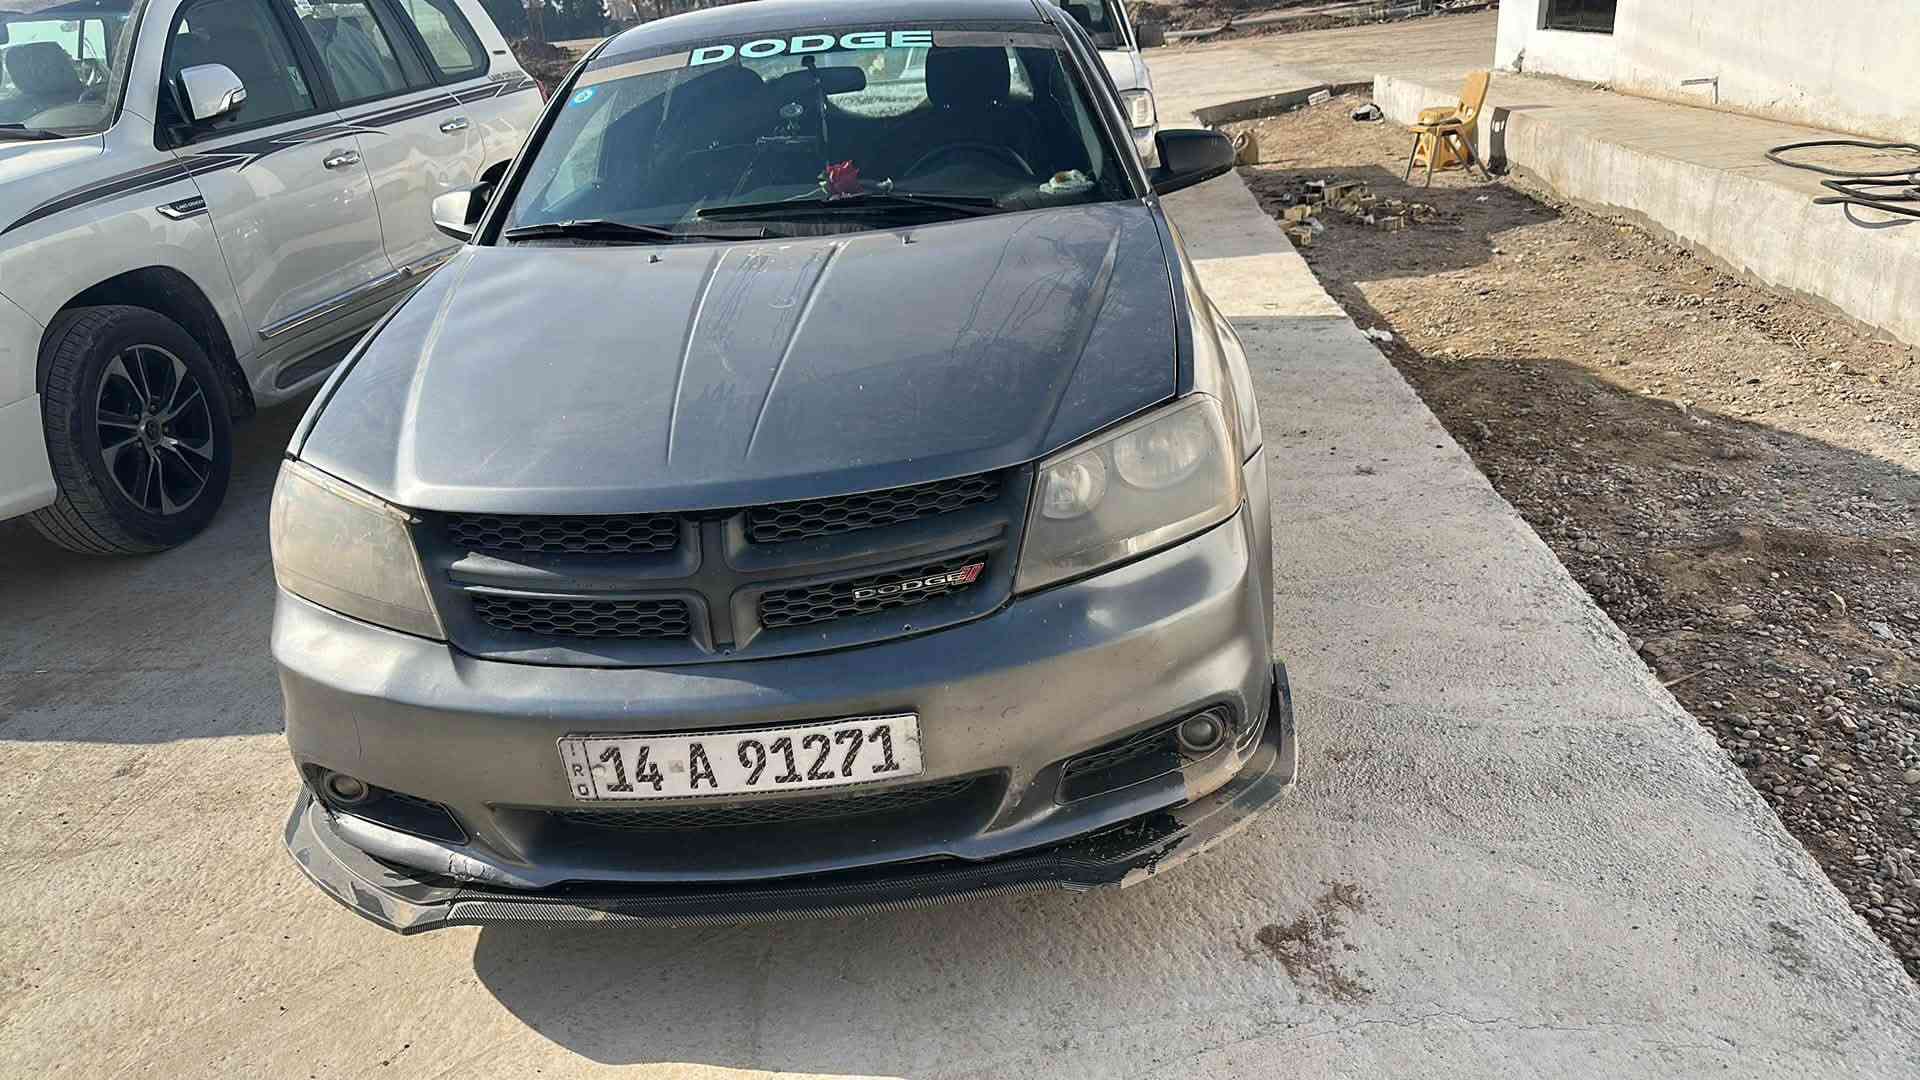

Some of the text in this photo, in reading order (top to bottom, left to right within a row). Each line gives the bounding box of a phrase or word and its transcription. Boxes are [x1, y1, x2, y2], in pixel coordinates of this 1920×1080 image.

[690, 30, 933, 66] DODGE
[854, 571, 962, 599] DODGE
[600, 725, 900, 792] 14 A 91271
